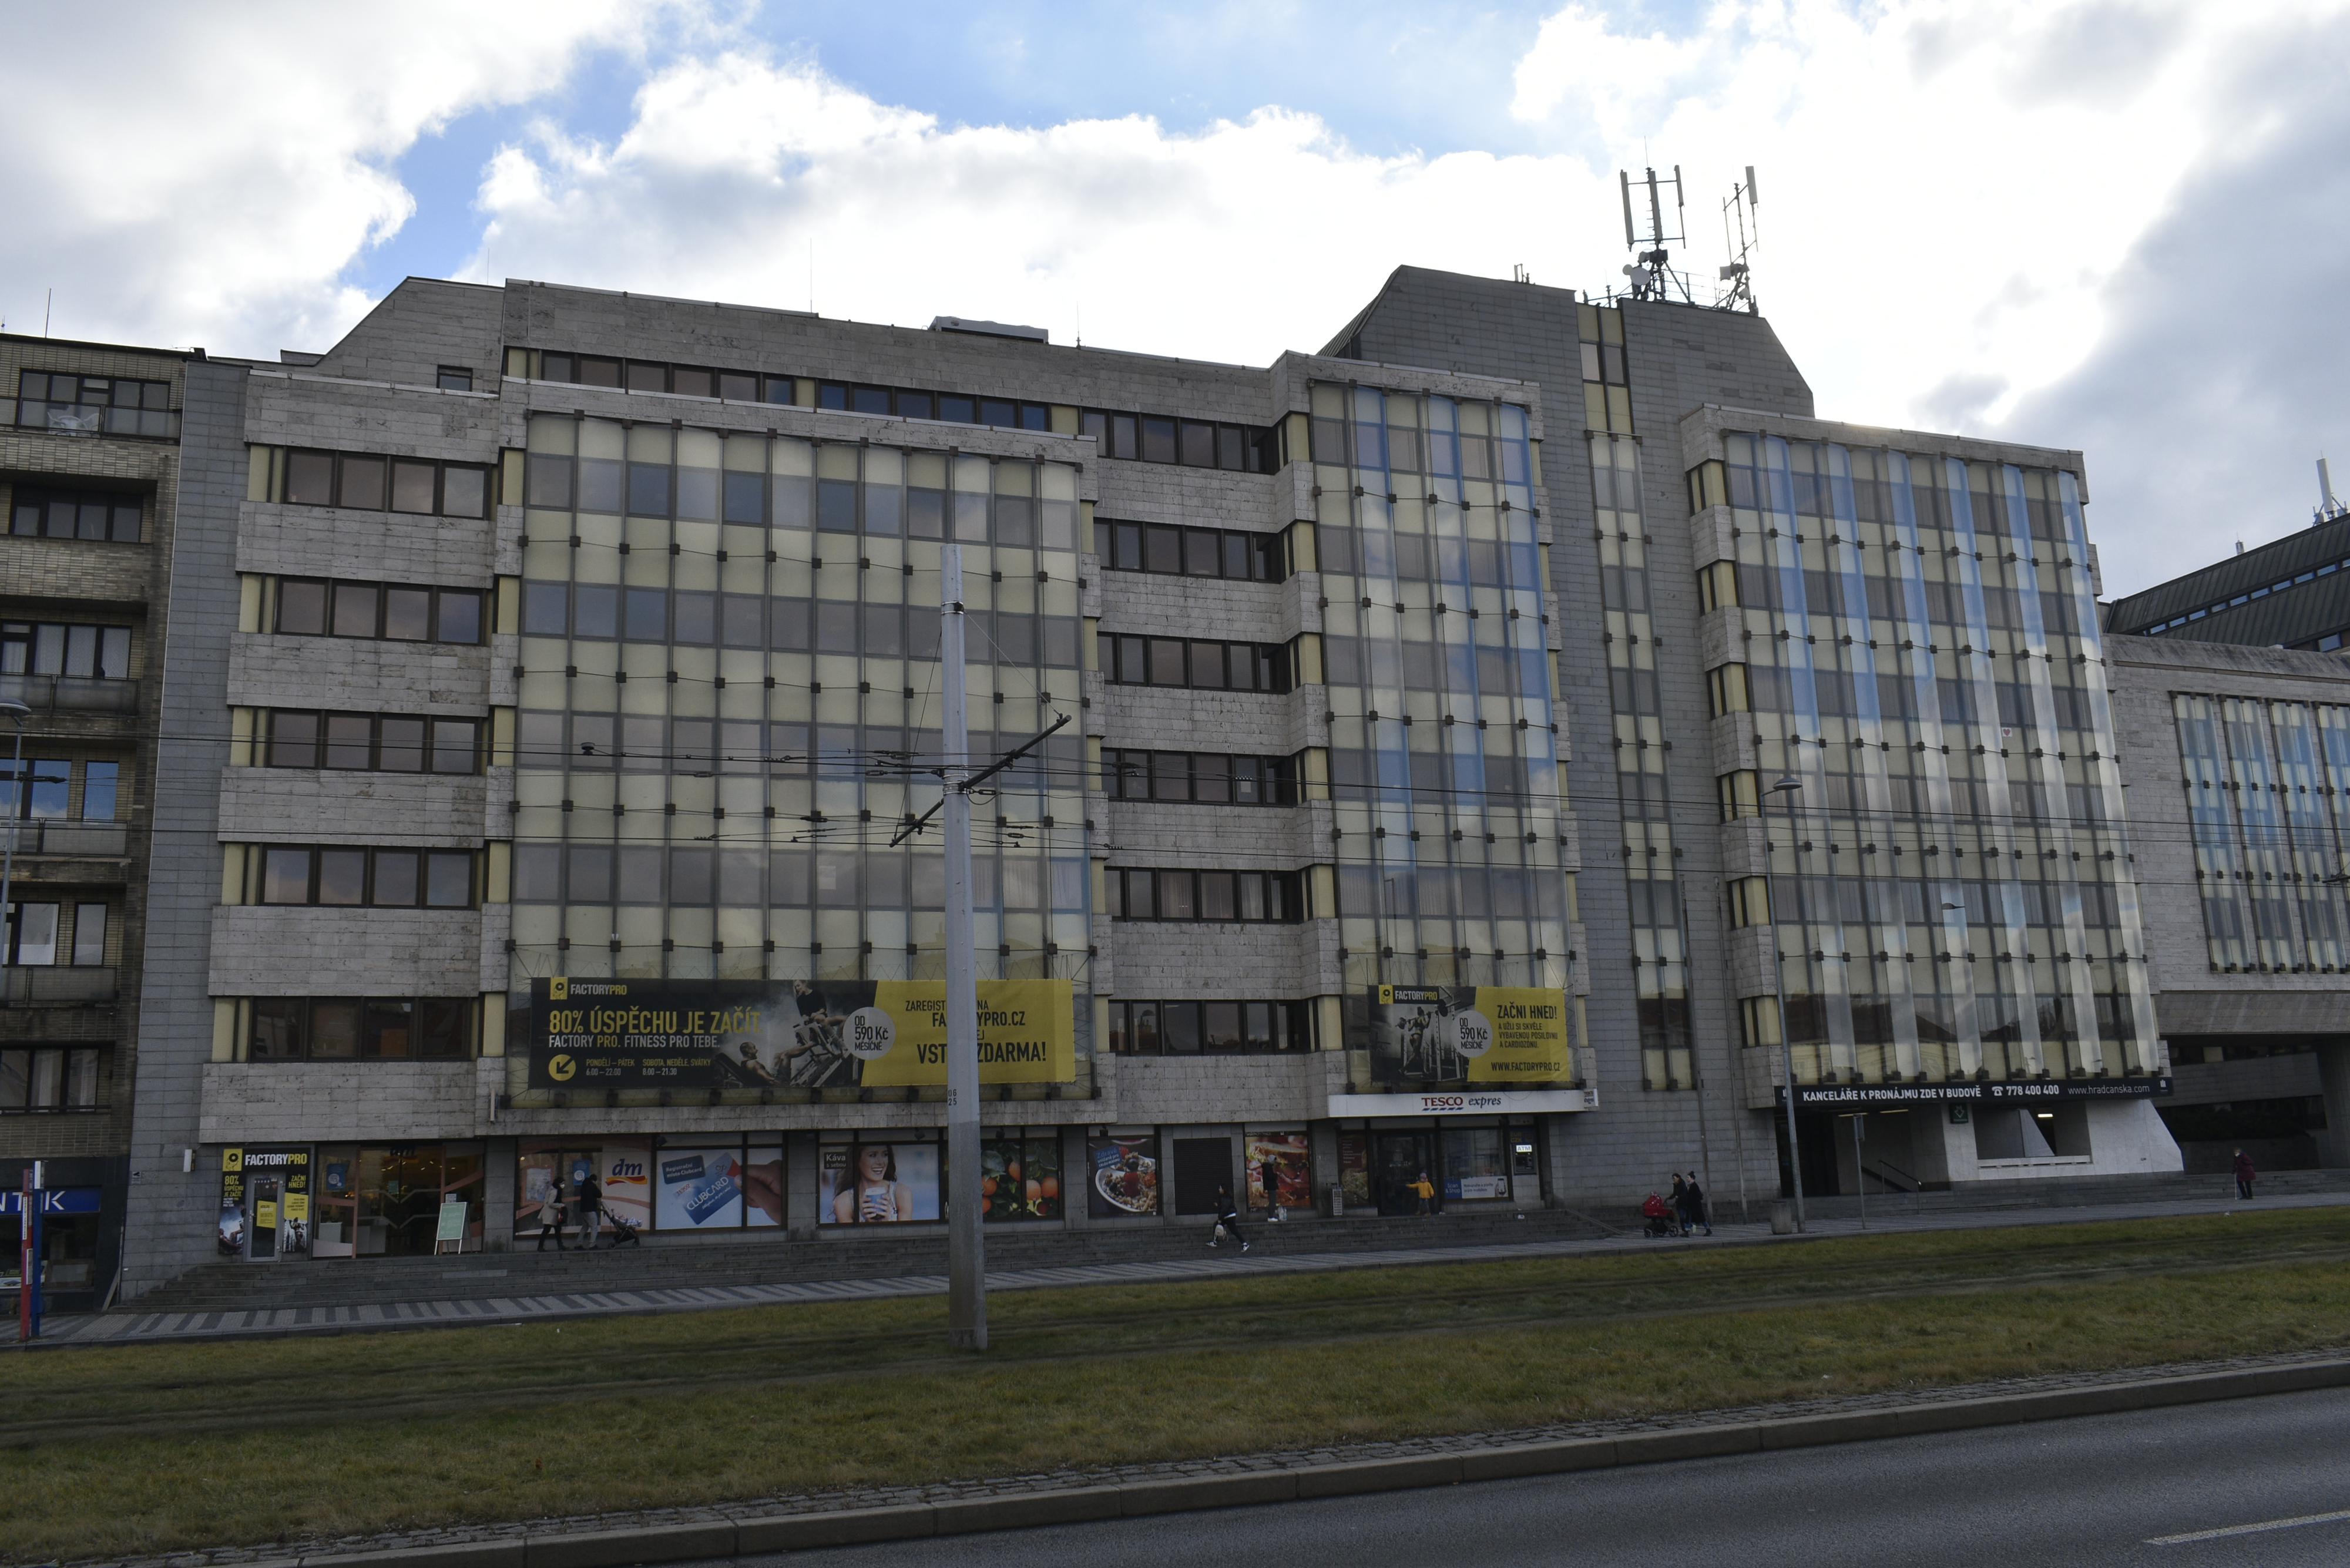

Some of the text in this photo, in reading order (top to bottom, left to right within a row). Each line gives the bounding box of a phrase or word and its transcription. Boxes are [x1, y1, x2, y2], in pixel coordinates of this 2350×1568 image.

[570, 984, 627, 995] FACTORYPRO
[1395, 991, 1438, 1001] FACTORYPRO
[905, 1000, 989, 1011] ZAREGIST NA
[1498, 1002, 1557, 1019] ZAČNI HNED!
[549, 1010, 583, 1035] 80%
[590, 1005, 677, 1034] ÚSPĚCHU
[682, 1010, 705, 1034] JE
[855, 1016, 865, 1026] OD
[932, 1010, 1025, 1027] FAYPRO.CZ
[1459, 1018, 1468, 1027] OD
[1522, 1022, 1542, 1030] SKVĚLE
[855, 1026, 888, 1040] 590 Kč
[1461, 1028, 1488, 1040] 590 Kč
[548, 1035, 720, 1048] FACTORY PRO. FITNESS PRO TEBE.
[855, 1040, 882, 1051] MĚSÍČNĚ
[1461, 1040, 1483, 1049] MĚSÍČNĚ
[916, 1041, 1046, 1064] VST ZDARMA!
[618, 1058, 635, 1067] PÁTEK
[690, 1058, 711, 1067] SVÁTKY
[1491, 1061, 1560, 1072] WWW.FACTORYPRO.CZ
[586, 1068, 597, 1076] 6:00
[605, 1068, 621, 1076] 22:00
[642, 1068, 654, 1076] 8:00
[661, 1068, 677, 1076] 21:30
[948, 1089, 957, 1097] 06
[1803, 1084, 1982, 1102] KANCELÁŘE K PRONÁJMU ZDE V BUDOVĚ
[2006, 1084, 2059, 1096] 778 400 400
[2067, 1083, 2150, 1094] www.hradcanska.com
[1421, 1096, 1502, 1109] TESCO expres
[244, 1153, 307, 1166] FACTORYPRO
[826, 1153, 846, 1161] Káva
[612, 1158, 642, 1176] dm
[224, 1175, 240, 1185] 80%
[291, 1174, 306, 1182] ZAČNI
[687, 1176, 729, 1210] CLUBCARD
[0, 1190, 66, 1212] TK
